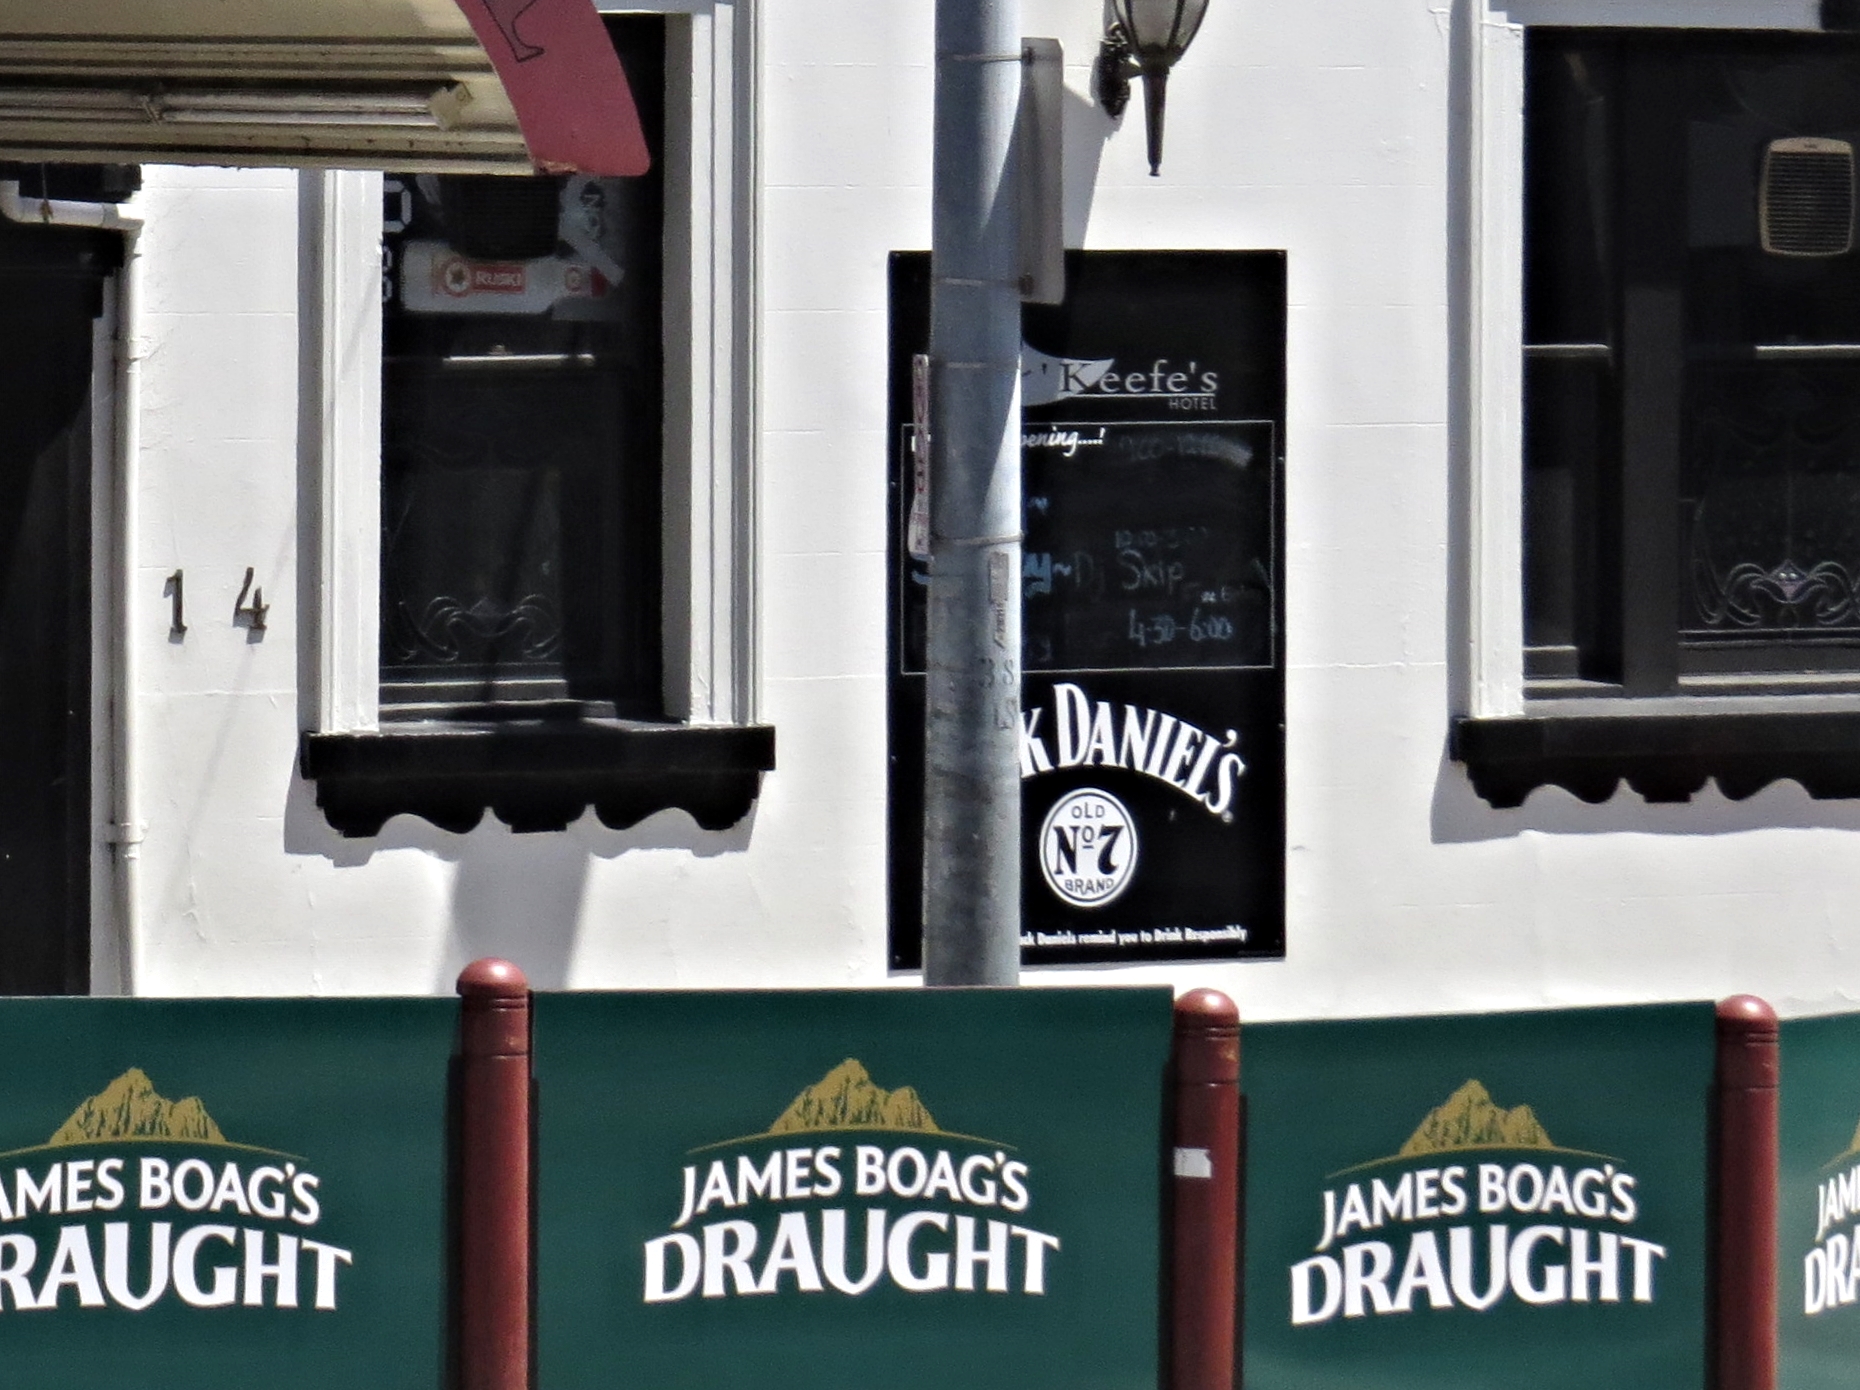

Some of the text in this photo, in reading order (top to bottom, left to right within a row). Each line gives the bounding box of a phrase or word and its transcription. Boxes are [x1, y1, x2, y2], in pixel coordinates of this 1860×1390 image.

[1168, 395, 1218, 411] HOTEL
[1054, 682, 1247, 815] DANIEL'S
[1071, 803, 1106, 819] OLD
[1063, 878, 1116, 895] BRAND
[1117, 931, 1139, 947] you
[1140, 930, 1152, 944] to
[138, 1156, 321, 1225] BOAG'S
[670, 1145, 1030, 1229] JAMES BOAG'S
[1314, 1162, 1638, 1252] JAMES BOAG'S
[1814, 1164, 1860, 1243] JAM
[643, 1207, 1060, 1304] DRAUGHT
[1289, 1223, 1667, 1327] DRAUGHT
